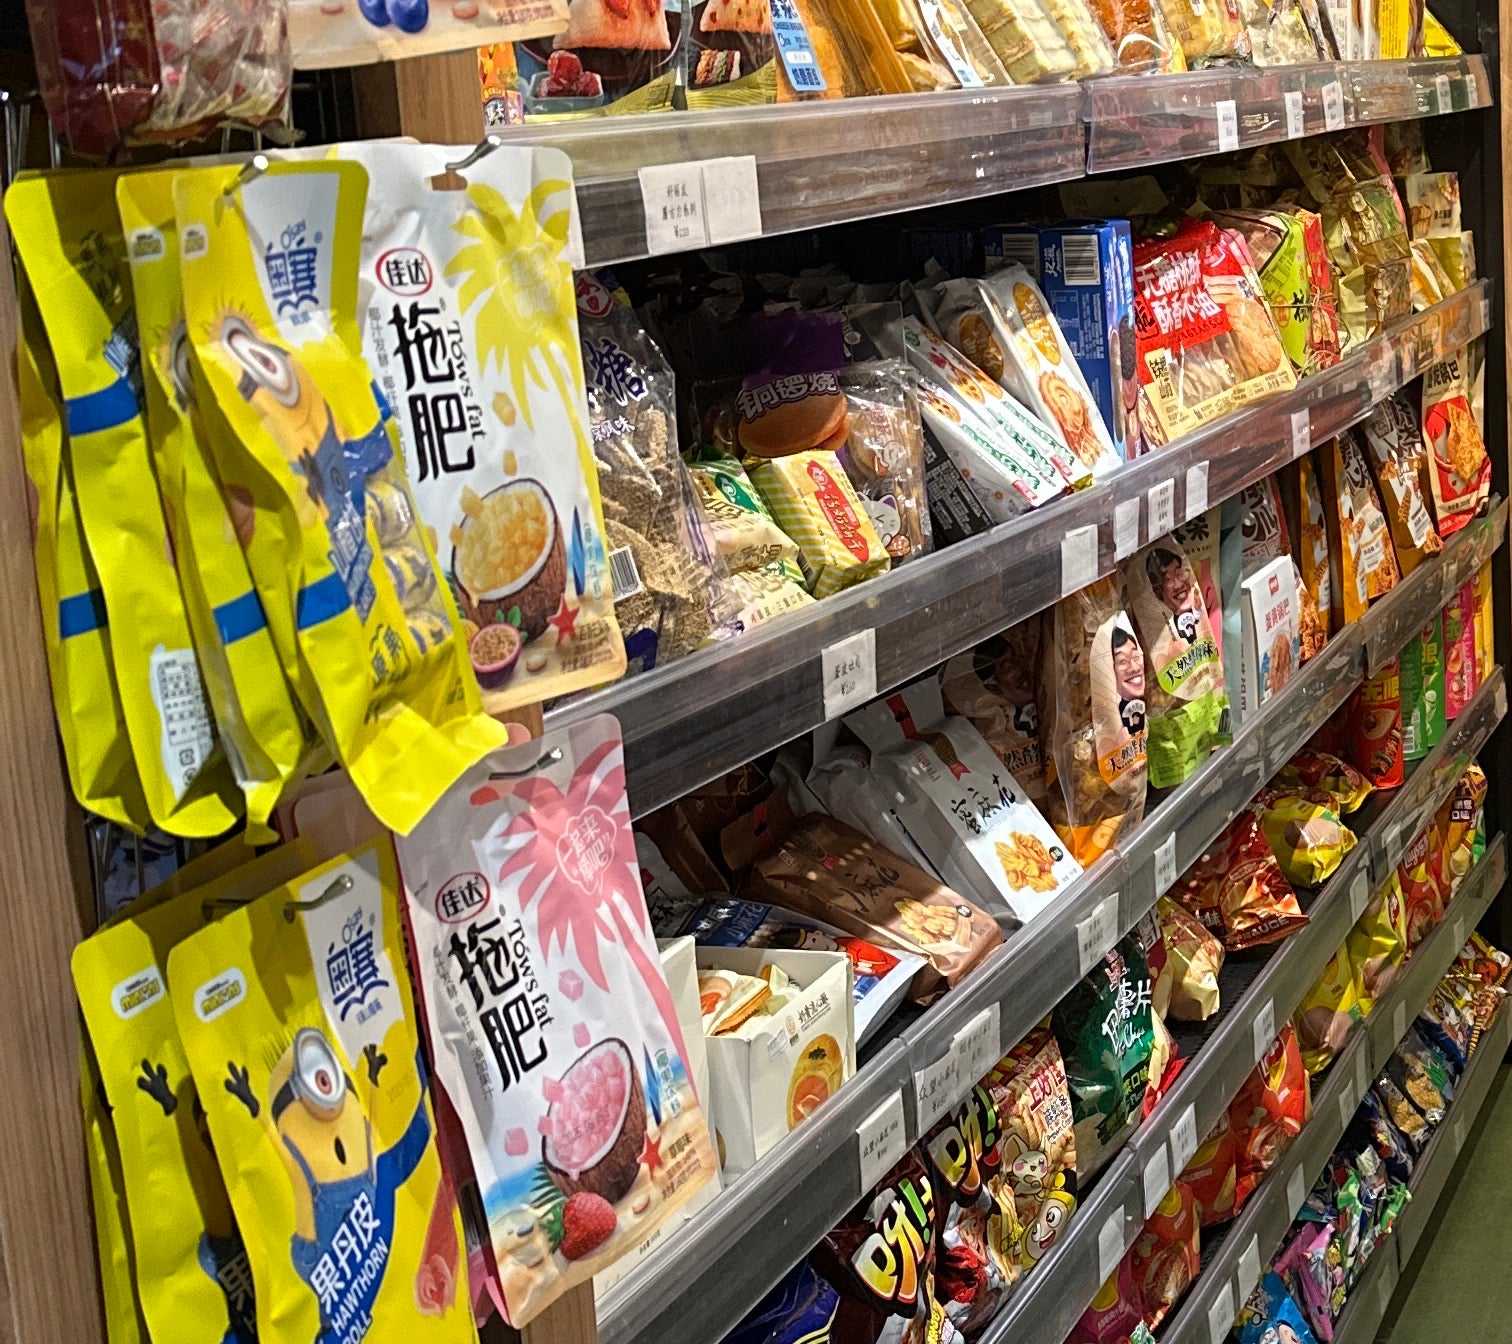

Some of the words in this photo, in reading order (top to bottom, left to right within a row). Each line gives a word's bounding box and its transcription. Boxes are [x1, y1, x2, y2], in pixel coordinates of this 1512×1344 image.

[385, 255, 430, 288] 佳达
[1135, 250, 1202, 299] 无糖桃酥
[1151, 289, 1223, 336] 酥香不油
[735, 370, 840, 422] 铜锣烧
[441, 875, 486, 918] 佳达
[447, 916, 548, 1093] 拖肥
[310, 1191, 381, 1315] 果丹皮
[331, 1236, 389, 1337] HAWTHORN
